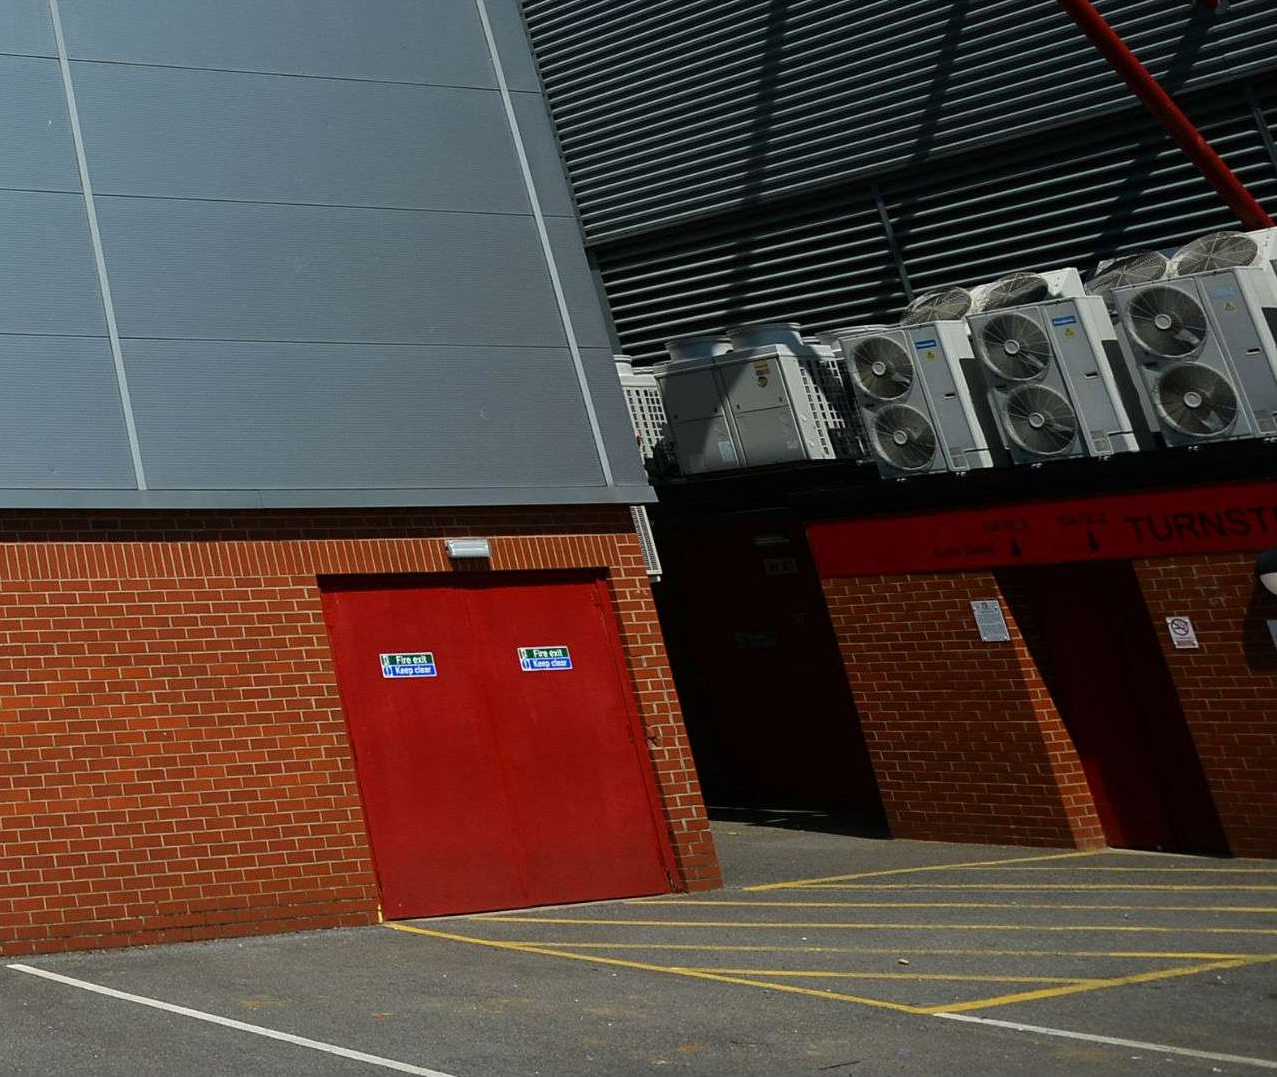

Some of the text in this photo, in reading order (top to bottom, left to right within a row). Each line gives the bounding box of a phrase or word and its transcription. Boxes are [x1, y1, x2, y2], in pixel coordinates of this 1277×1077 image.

[533, 649, 563, 658] Fire exit
[396, 655, 428, 664] Fire exit
[532, 659, 567, 668] Keep clear
[395, 665, 432, 676] Keep clear
